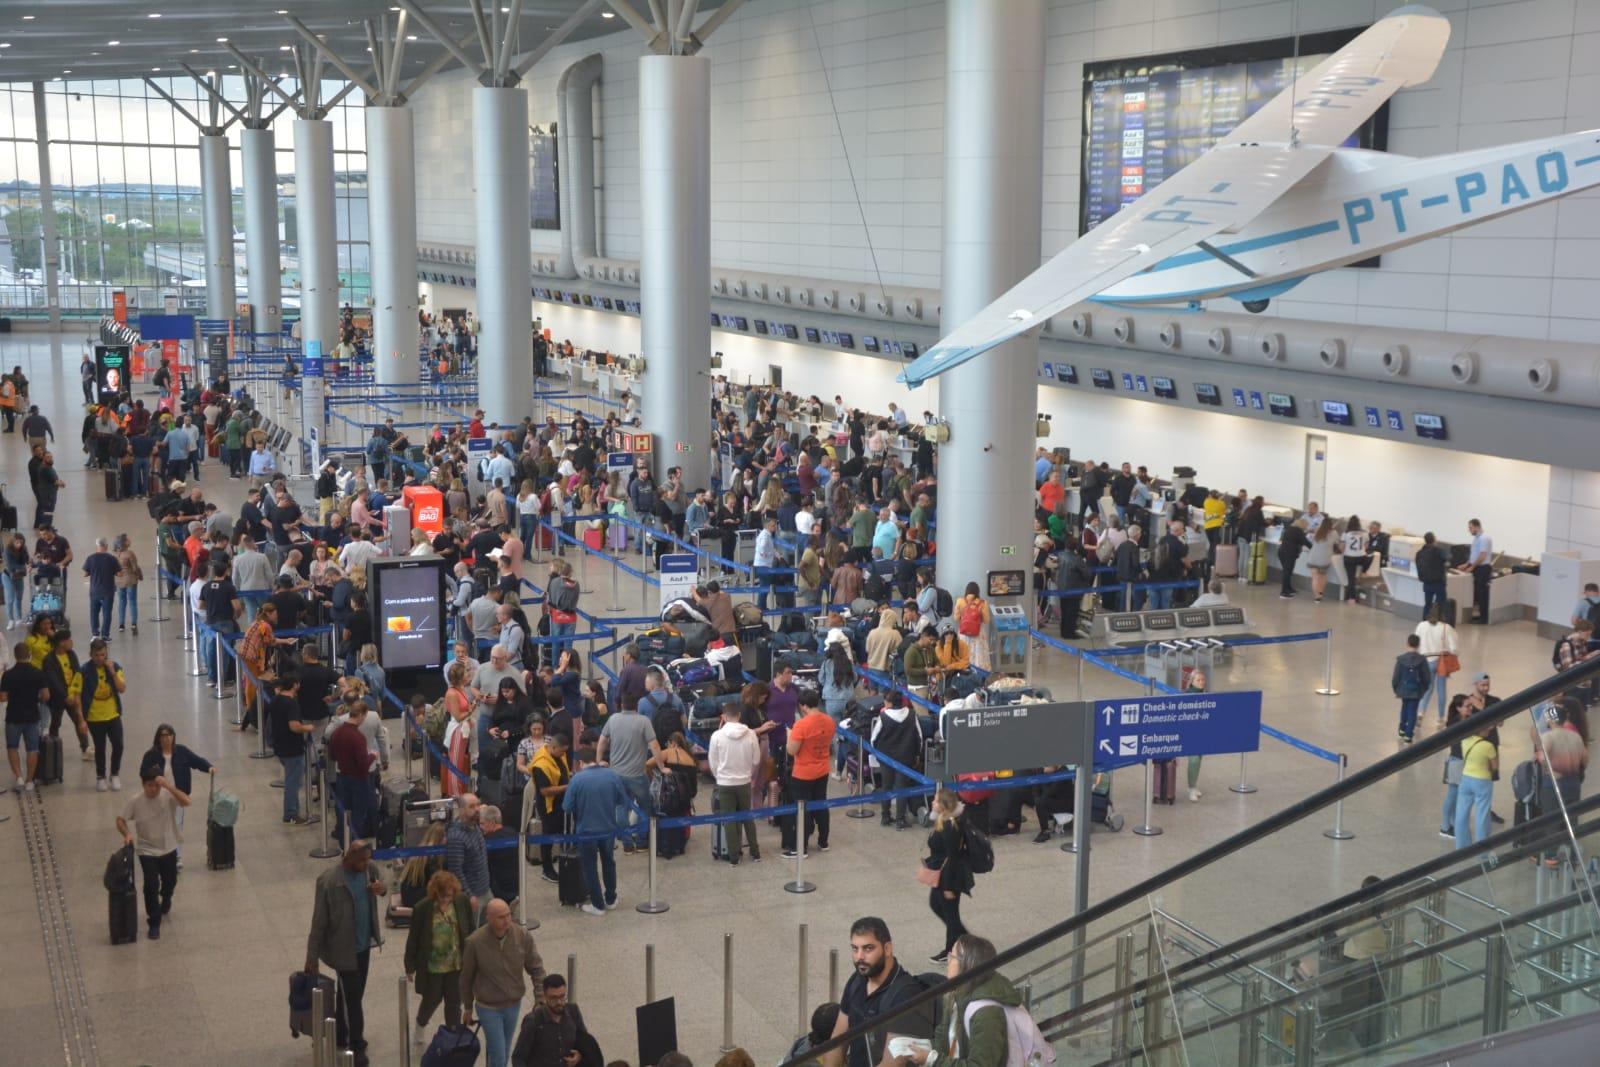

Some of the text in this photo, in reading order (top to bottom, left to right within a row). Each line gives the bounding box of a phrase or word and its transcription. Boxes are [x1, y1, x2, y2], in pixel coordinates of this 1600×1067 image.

[1343, 151, 1569, 245] PT-PAQ
[1349, 536, 1363, 551] 21
[1143, 700, 1217, 712] Check-in doméstico
[1142, 711, 1210, 723] Domestic check-in
[1142, 733, 1180, 743] Embarque
[1141, 745, 1182, 755] Departures
